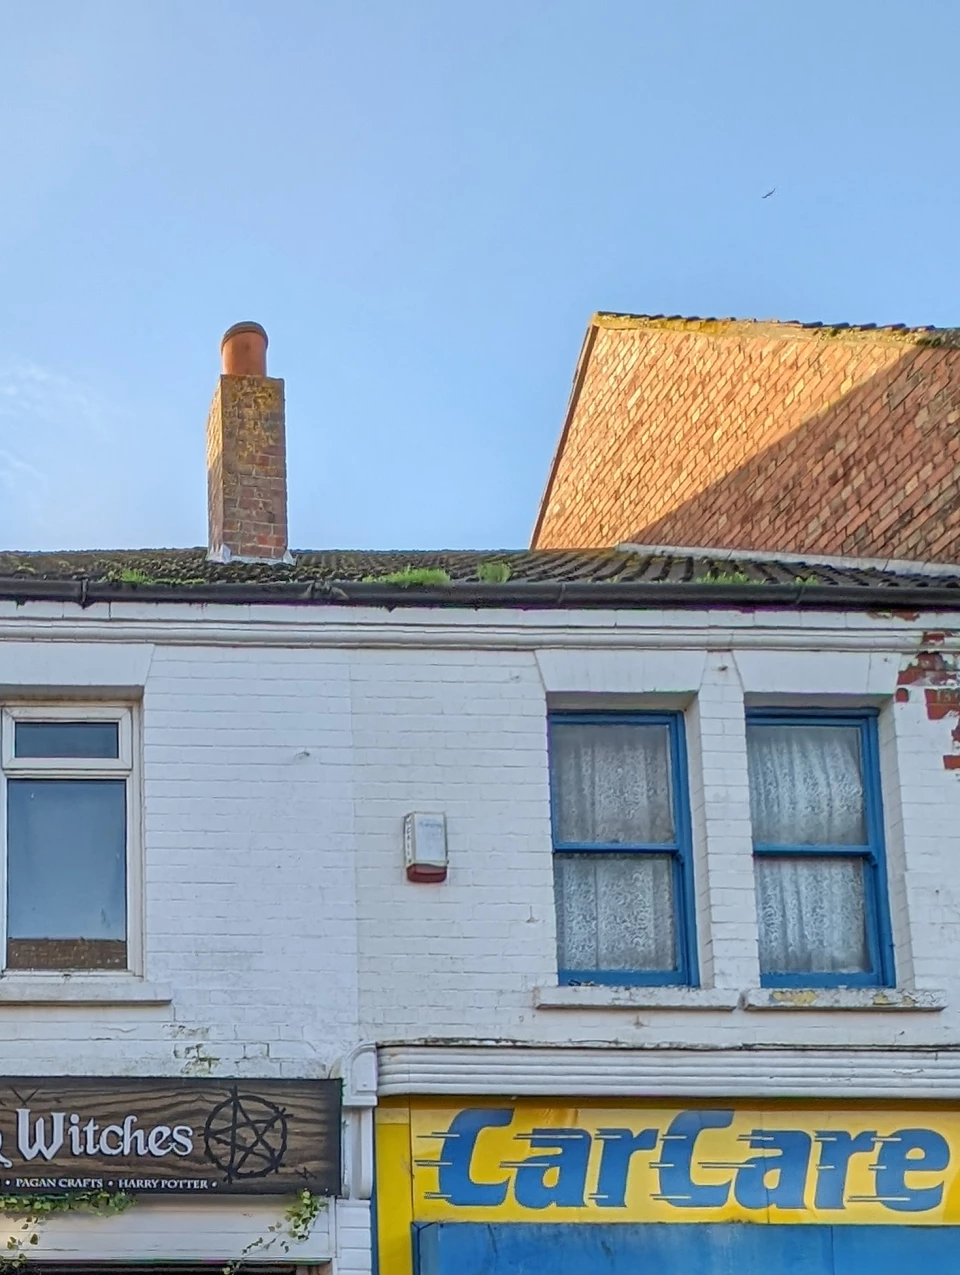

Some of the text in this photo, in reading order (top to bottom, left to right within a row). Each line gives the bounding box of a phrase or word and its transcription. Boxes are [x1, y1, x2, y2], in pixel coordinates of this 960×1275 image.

[16, 1107, 194, 1161] Witches
[416, 1107, 951, 1212] CarCare
[15, 1177, 56, 1188] PAGAN
[58, 1178, 103, 1188] CRAFTS
[118, 1178, 160, 1189] HARRY
[161, 1179, 208, 1189] POTTER
